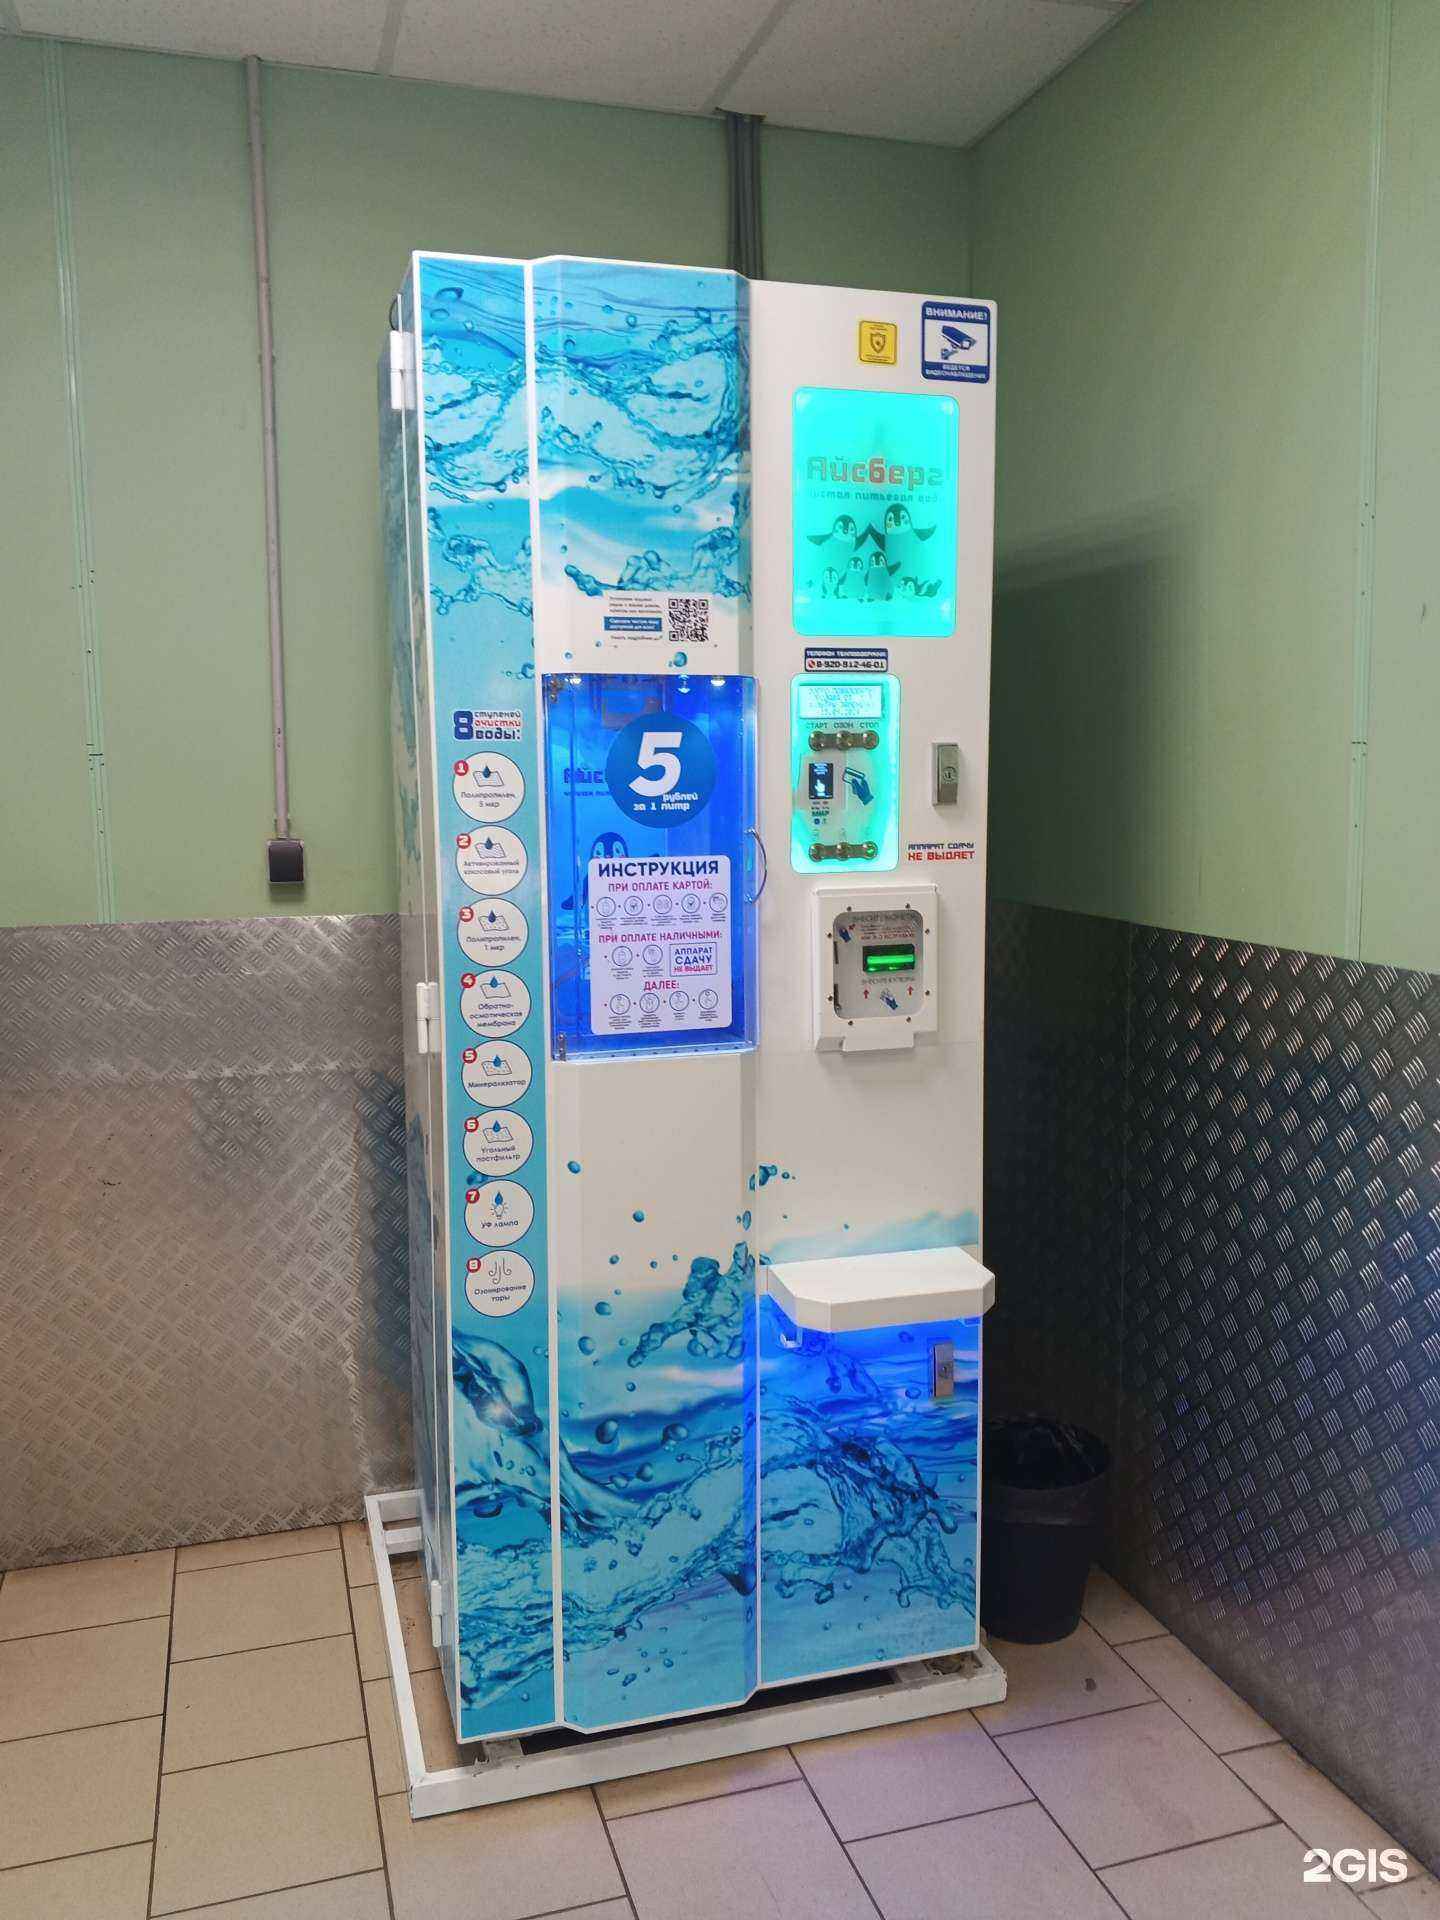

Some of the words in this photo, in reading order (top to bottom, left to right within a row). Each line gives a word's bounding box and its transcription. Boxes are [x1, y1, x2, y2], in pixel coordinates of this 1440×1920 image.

[925, 307, 988, 320] ВНИМАНИЕ!
[807, 456, 944, 491] Айсберг
[855, 491, 914, 502] питьевая
[474, 711, 521, 719] ступеней
[453, 710, 474, 740] 8
[474, 719, 521, 727] очистки
[628, 731, 683, 797] 5
[662, 792, 698, 802] рублей
[633, 802, 646, 811] за
[650, 802, 657, 811] 1
[660, 801, 690, 812] литр
[458, 835, 469, 847] 2
[908, 852, 923, 861] НЕ
[927, 850, 975, 861] ВЫДАЕТ
[598, 860, 719, 877] ИНСТРУКЦИЯ
[608, 883, 629, 893] ПРИ
[631, 881, 669, 892] ОПЛАТЕ
[672, 878, 712, 890] КАРТОЙ:
[461, 908, 472, 920] 3
[598, 934, 618, 944] ПРИ
[621, 933, 657, 943] ОПЛАТЕ
[660, 930, 722, 942] НАЛИЧНЫМИ:
[675, 946, 713, 956] АППАРАТ
[675, 955, 712, 966] СДАЧУ
[674, 965, 683, 973] НЕ
[684, 965, 713, 973] ВЫДАЕТ
[463, 974, 474, 987] 4
[643, 980, 680, 992] ДАЛЕЕ:
[465, 1050, 475, 1062] 5
[466, 1119, 476, 1131] 6
[468, 1190, 477, 1202] 7
[468, 1260, 479, 1271] 8
